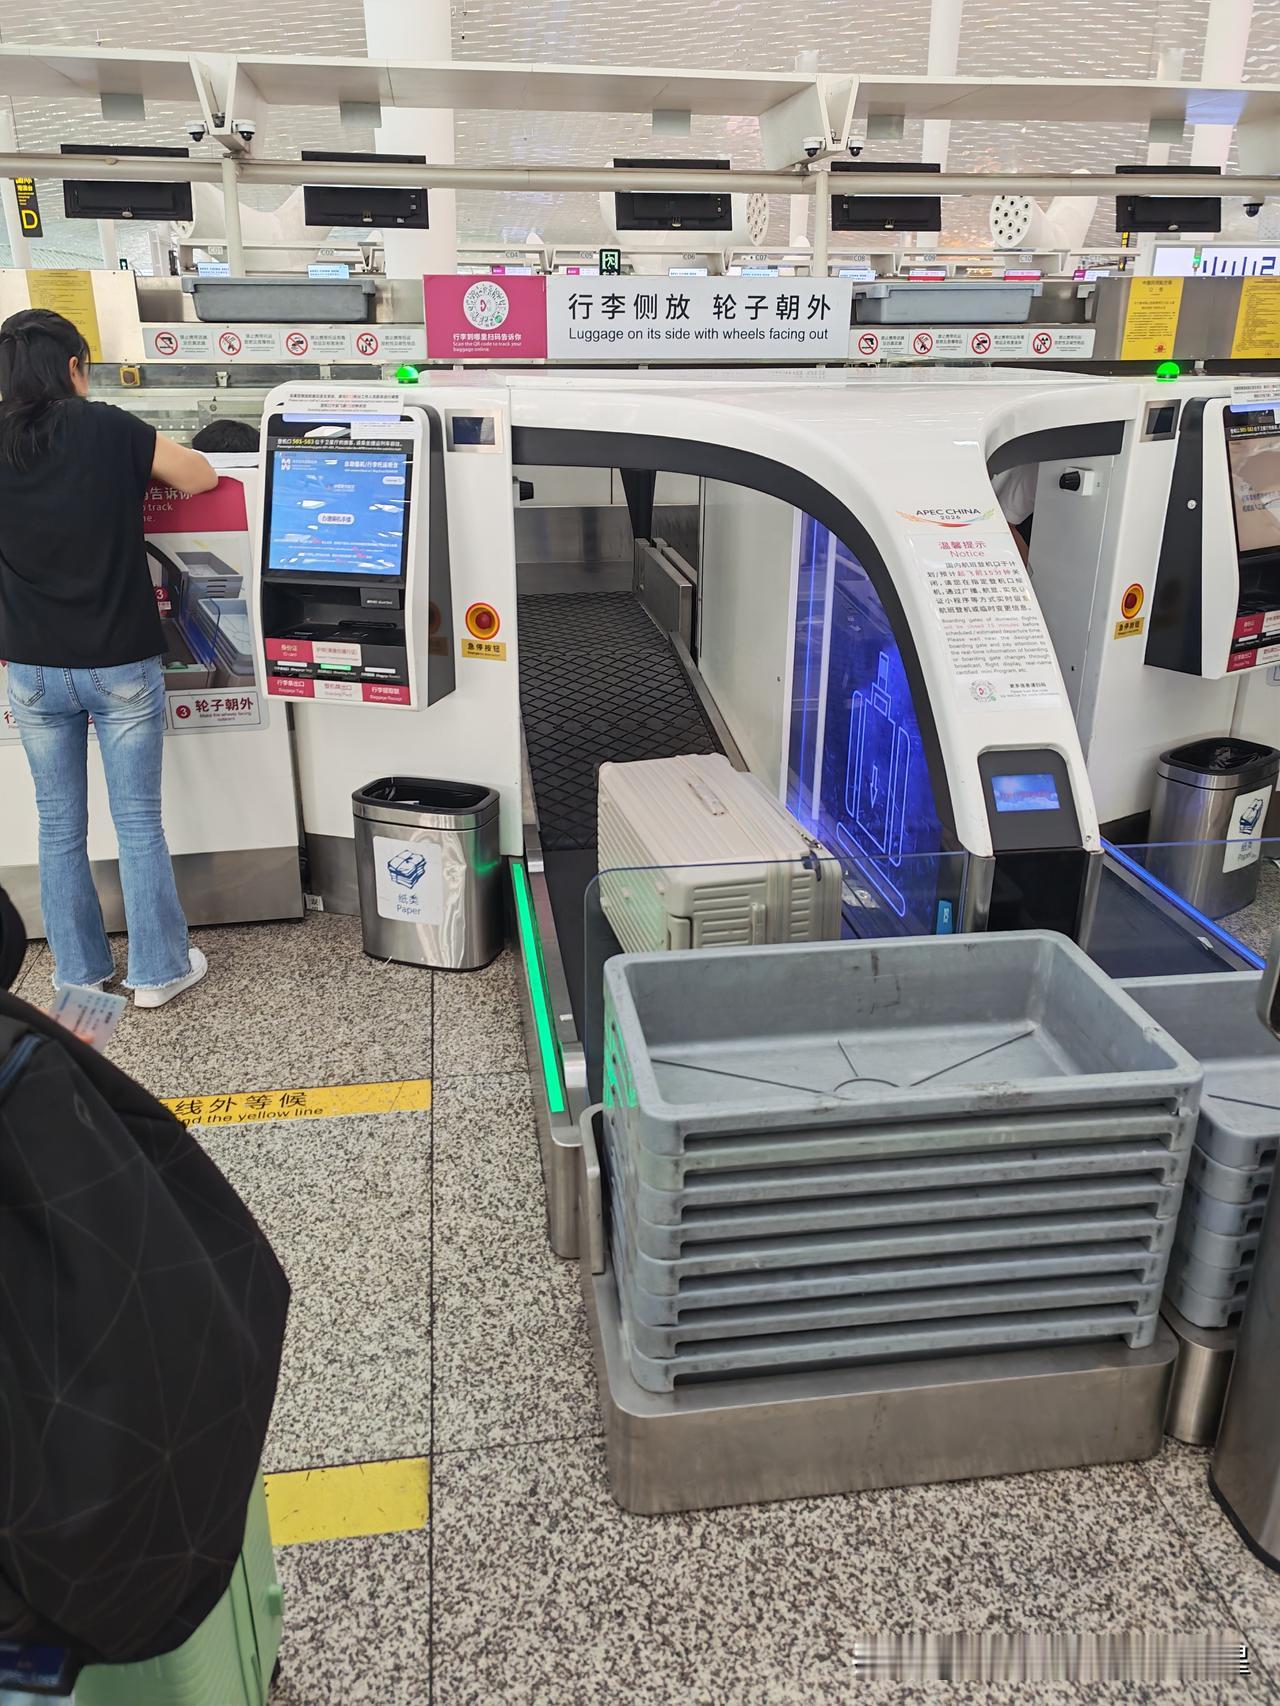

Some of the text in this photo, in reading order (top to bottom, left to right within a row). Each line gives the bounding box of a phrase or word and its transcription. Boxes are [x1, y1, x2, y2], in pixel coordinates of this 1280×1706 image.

[21, 209, 38, 229] D
[568, 293, 831, 321] 行李侧放 轮子朝外
[569, 327, 829, 343] Luggage on its side with wheels facing out
[148, 502, 173, 512] track
[916, 508, 944, 516] APEC
[938, 540, 986, 550] 温馨提示
[950, 550, 985, 558] Notice
[156, 589, 164, 599] 3
[195, 697, 254, 712] 轮子朝外
[179, 707, 187, 717] 3
[396, 904, 421, 915] Paper
[163, 1092, 308, 1116] 线外等候
[207, 1114, 233, 1124] the
[238, 1108, 290, 1123] yellow
[295, 1107, 324, 1117] line
